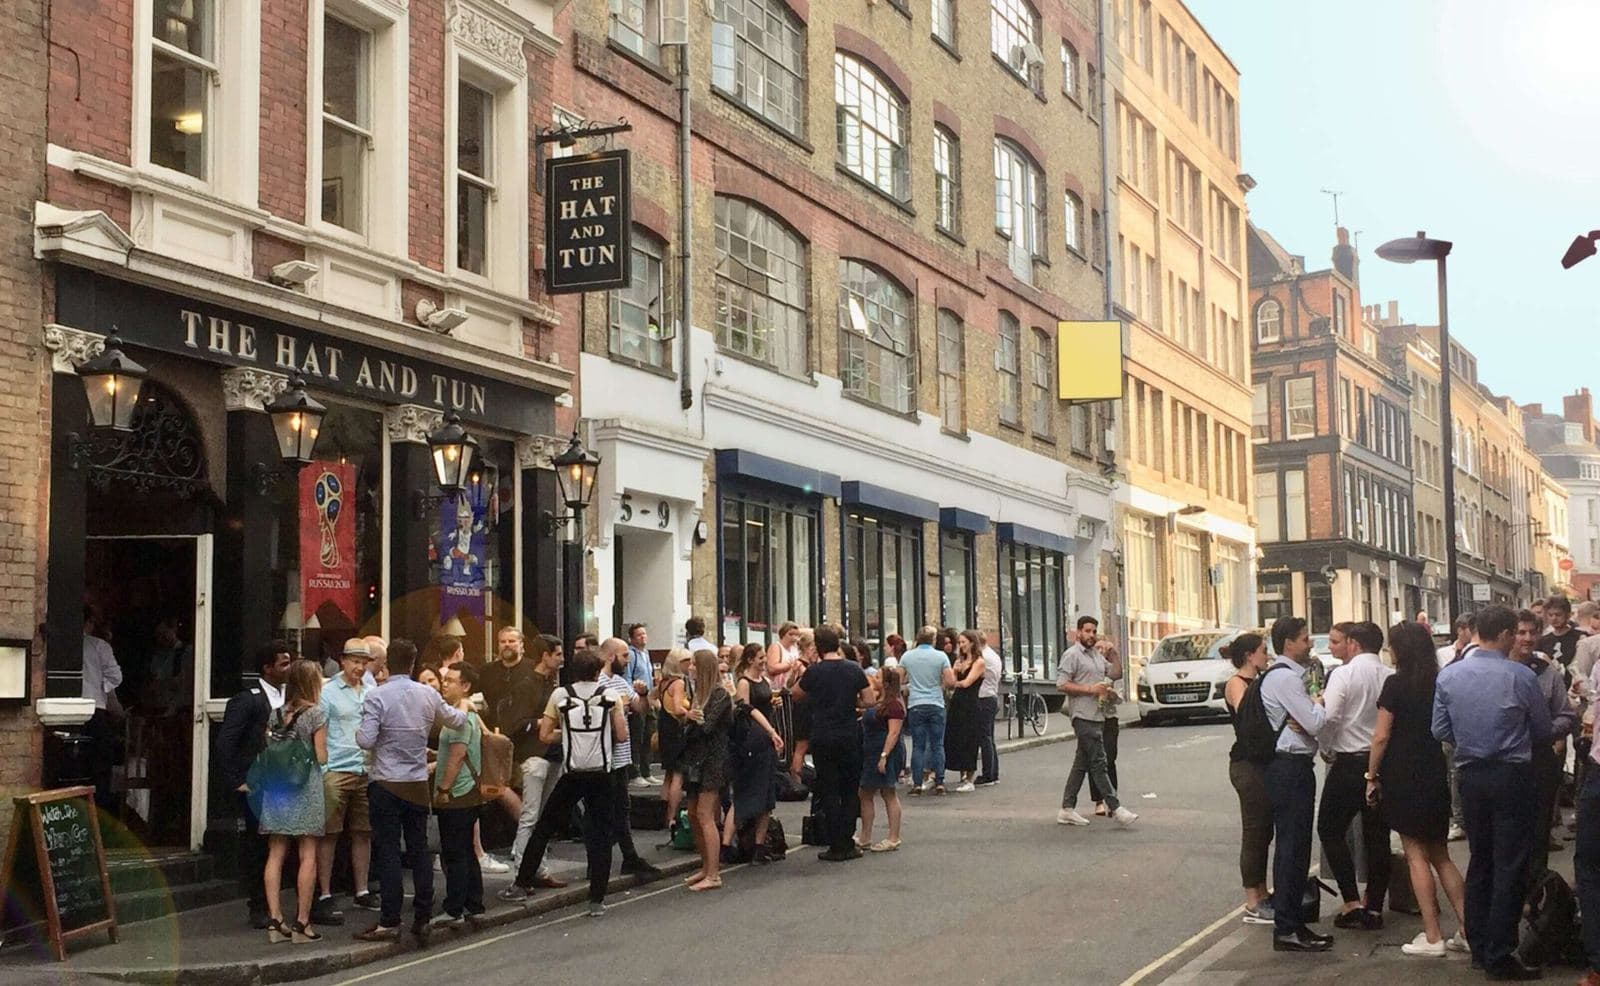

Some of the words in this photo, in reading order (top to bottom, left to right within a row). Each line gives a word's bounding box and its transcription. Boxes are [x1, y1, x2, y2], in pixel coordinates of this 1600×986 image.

[570, 176, 604, 191] THE
[560, 196, 616, 220] HAT
[570, 225, 605, 239] AND
[560, 245, 616, 268] TUN
[181, 309, 257, 361] THE
[275, 333, 344, 381] HAT
[355, 357, 418, 397] AND
[431, 374, 486, 416] TUN
